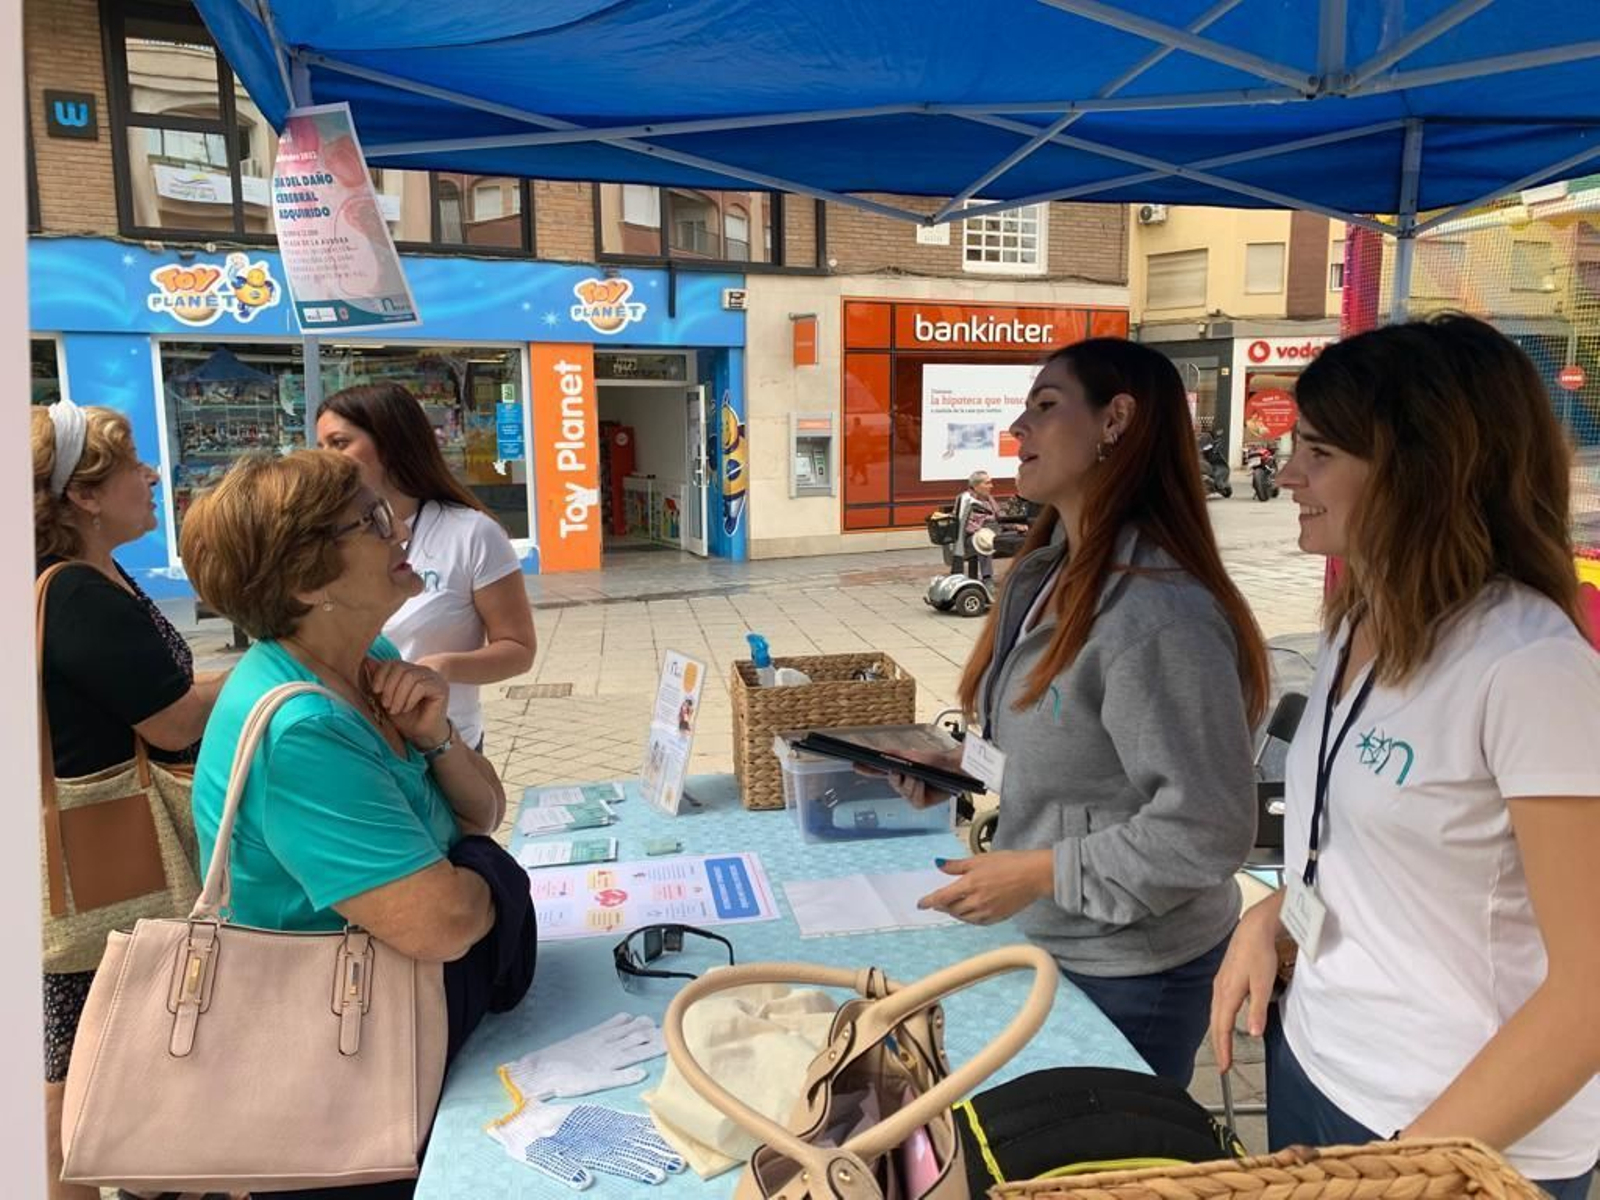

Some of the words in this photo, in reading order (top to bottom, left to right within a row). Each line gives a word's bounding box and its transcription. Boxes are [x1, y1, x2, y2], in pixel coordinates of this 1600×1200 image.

[302, 172, 333, 186] DAÑO
[156, 267, 221, 293] TOY
[152, 294, 236, 308] PLANET
[578, 280, 628, 304] TOY
[574, 305, 641, 318] PLANET
[915, 313, 1054, 343] bankinter.
[1276, 343, 1326, 358] voda
[941, 394, 983, 408] hipoteca
[984, 396, 1002, 408] que
[1003, 394, 1026, 407] busc
[553, 359, 587, 472] Planet
[559, 482, 600, 539] Toy
